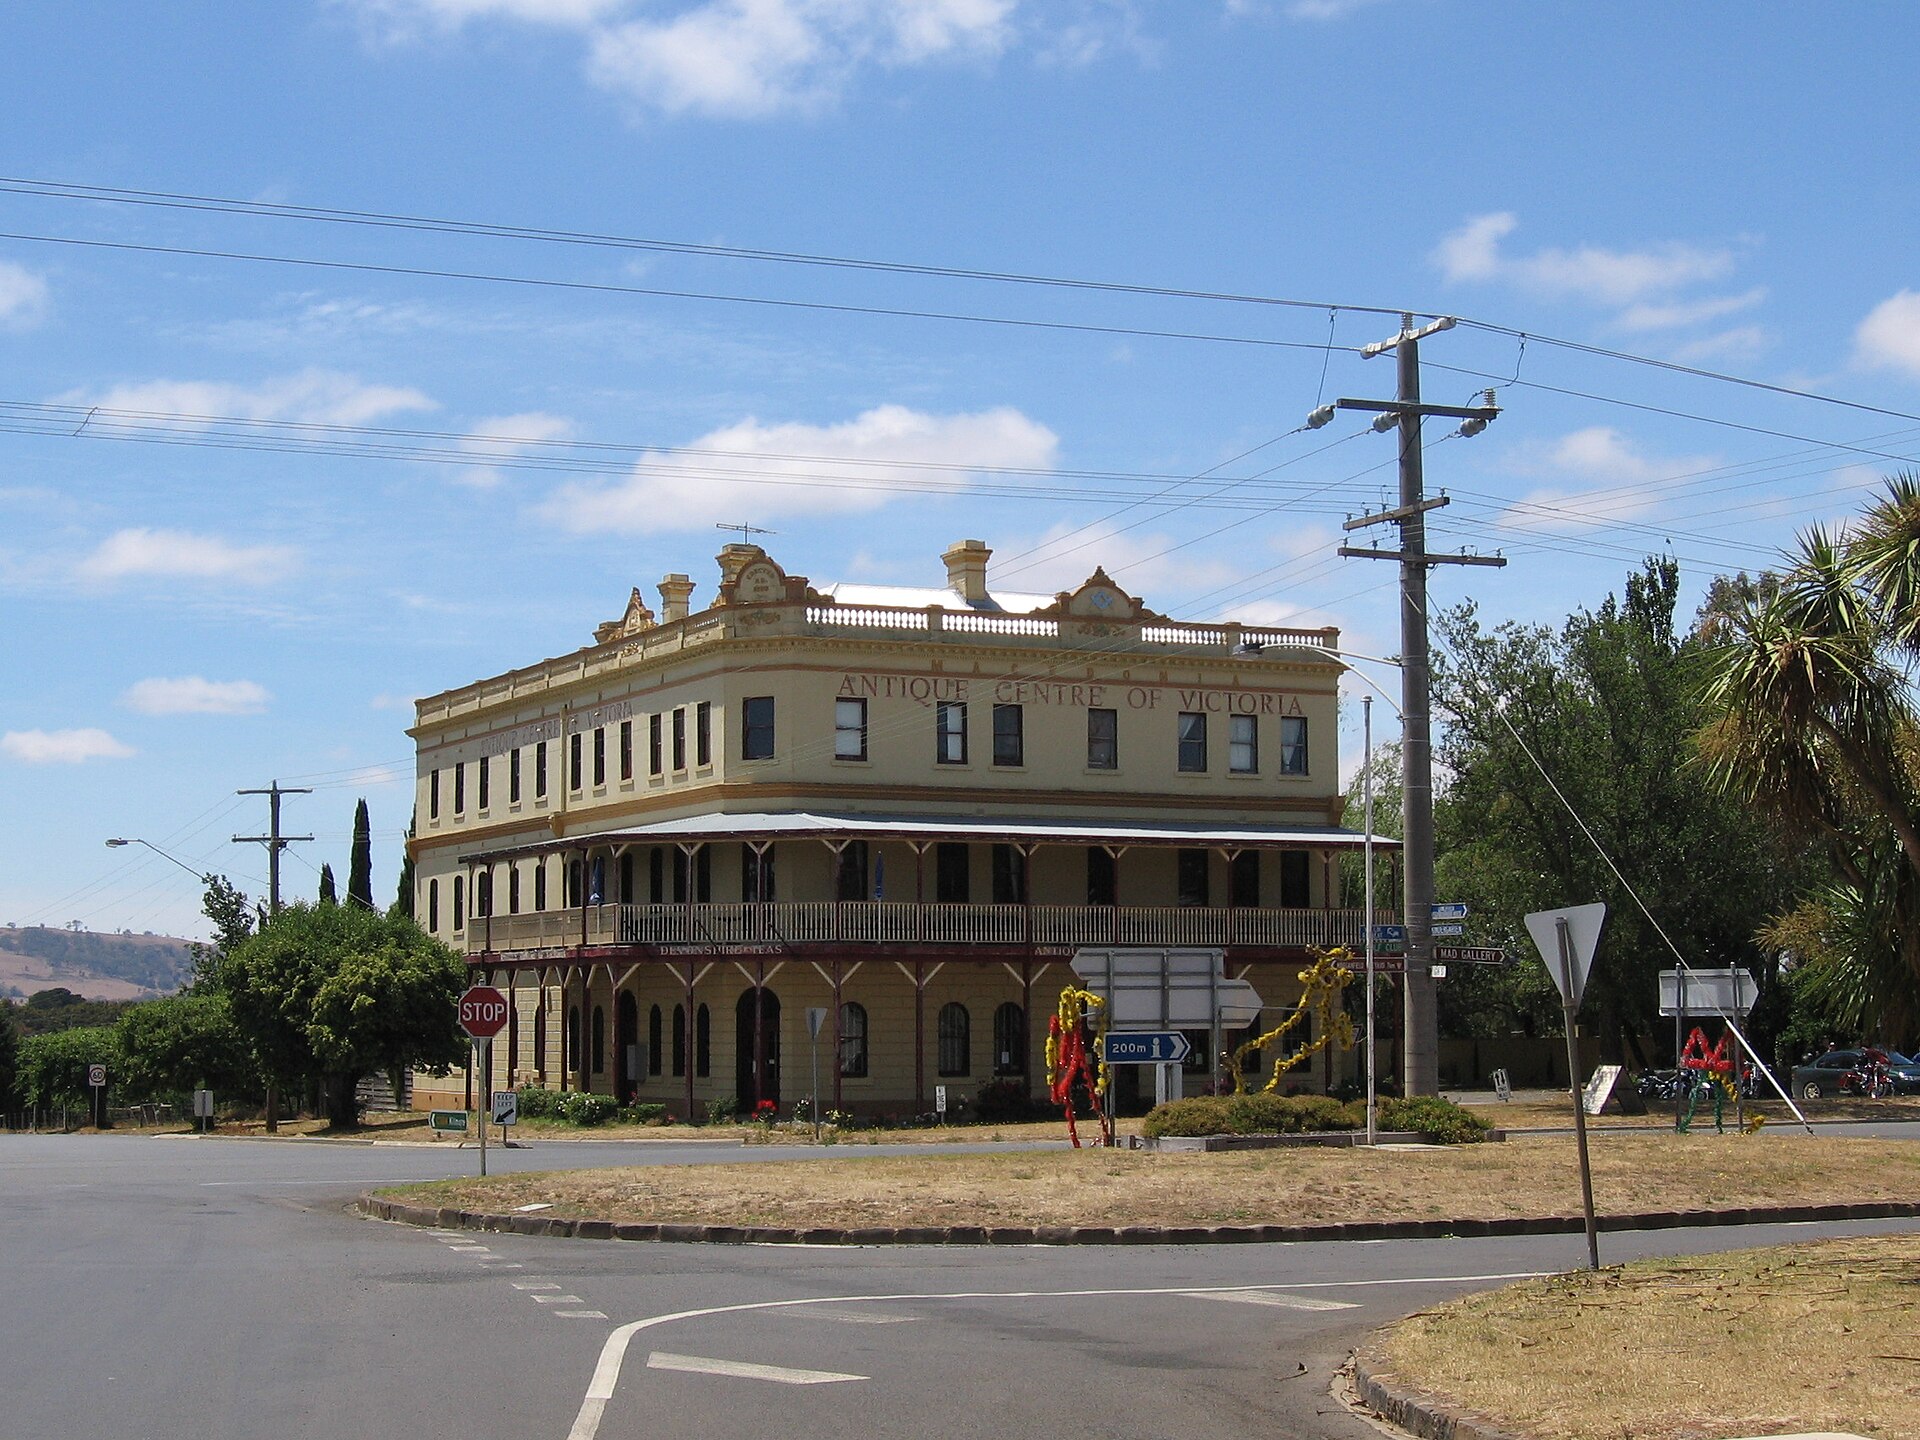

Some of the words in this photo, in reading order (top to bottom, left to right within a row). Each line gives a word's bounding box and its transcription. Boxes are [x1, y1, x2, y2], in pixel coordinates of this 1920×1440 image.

[838, 673, 970, 707] ANTIQUE
[995, 681, 1107, 708] CENTRE
[1127, 688, 1163, 710] OF
[1179, 689, 1308, 716] VICTORIA
[752, 944, 783, 955] TEAS
[1034, 946, 1077, 956] ANTIQU
[1440, 948, 1458, 959] MAD
[1461, 949, 1496, 961] GALLERY
[462, 1003, 505, 1021] STOP
[1111, 1043, 1147, 1053] 200m
[93, 1071, 103, 1079] 60
